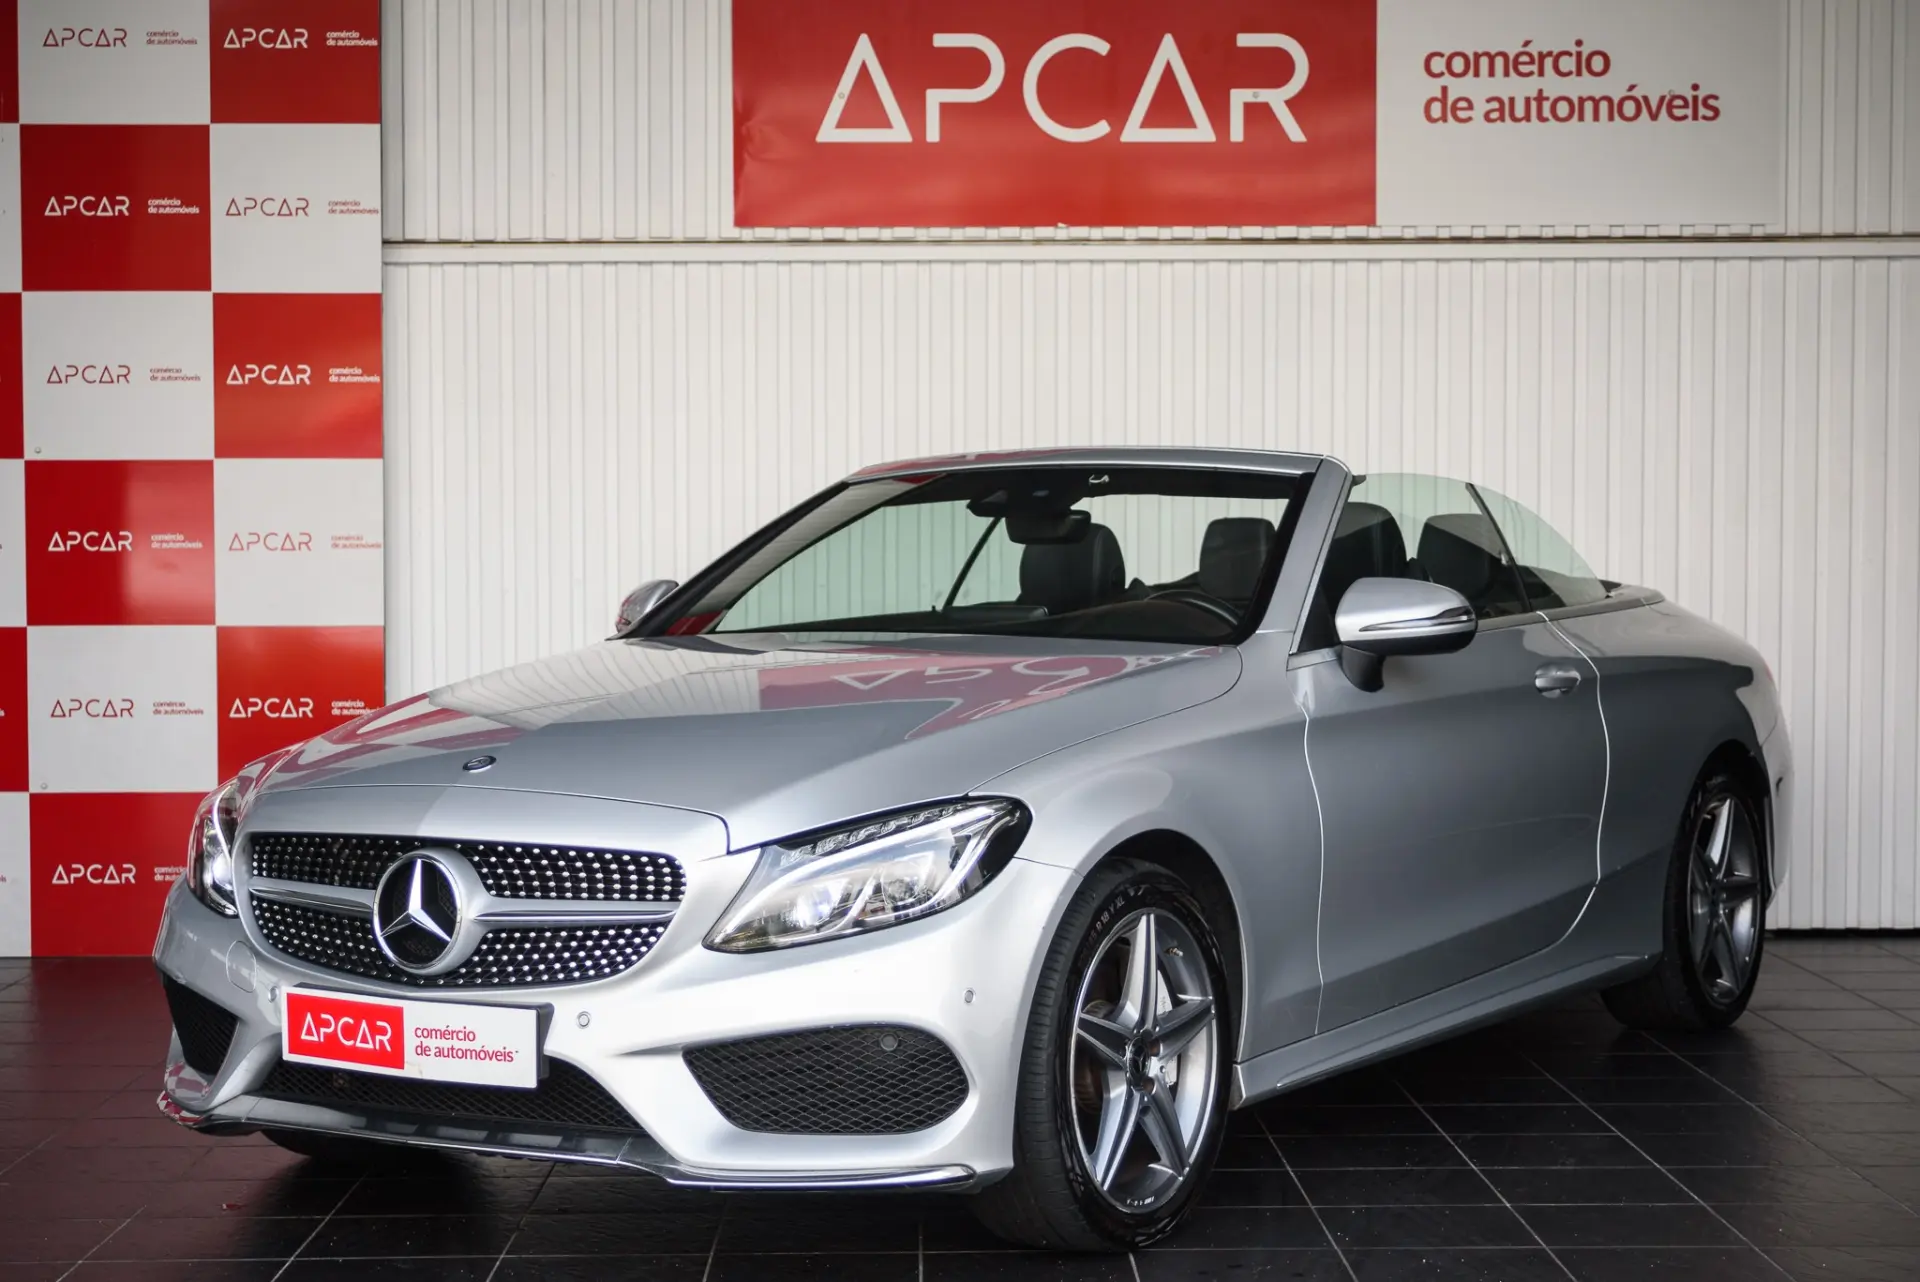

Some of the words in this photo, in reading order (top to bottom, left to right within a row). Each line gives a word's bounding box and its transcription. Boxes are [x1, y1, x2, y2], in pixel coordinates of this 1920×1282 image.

[43, 28, 127, 48] APCAR
[146, 38, 156, 46] de
[224, 28, 308, 48] APCAR
[326, 38, 336, 46] de
[1423, 39, 1611, 78] comércio
[815, 32, 1310, 143] APCAR
[1423, 85, 1474, 123] de
[1483, 83, 1721, 123] automóveis
[44, 196, 129, 216] APCAR
[148, 206, 157, 214] de
[226, 198, 309, 216] APCAR
[47, 365, 130, 384] APCAR
[149, 374, 159, 382] de
[226, 364, 311, 385] APCAR
[329, 375, 339, 383] de
[48, 531, 133, 552] APCAR
[229, 532, 312, 551] APCAR
[51, 699, 134, 718] APCAR
[153, 708, 162, 716] de
[229, 698, 313, 719] APCAR
[52, 864, 136, 884] APCAR
[300, 1011, 393, 1052] APCAR
[414, 1024, 477, 1043] comércio
[415, 1041, 432, 1057] de
[434, 1043, 514, 1063] automóveis
